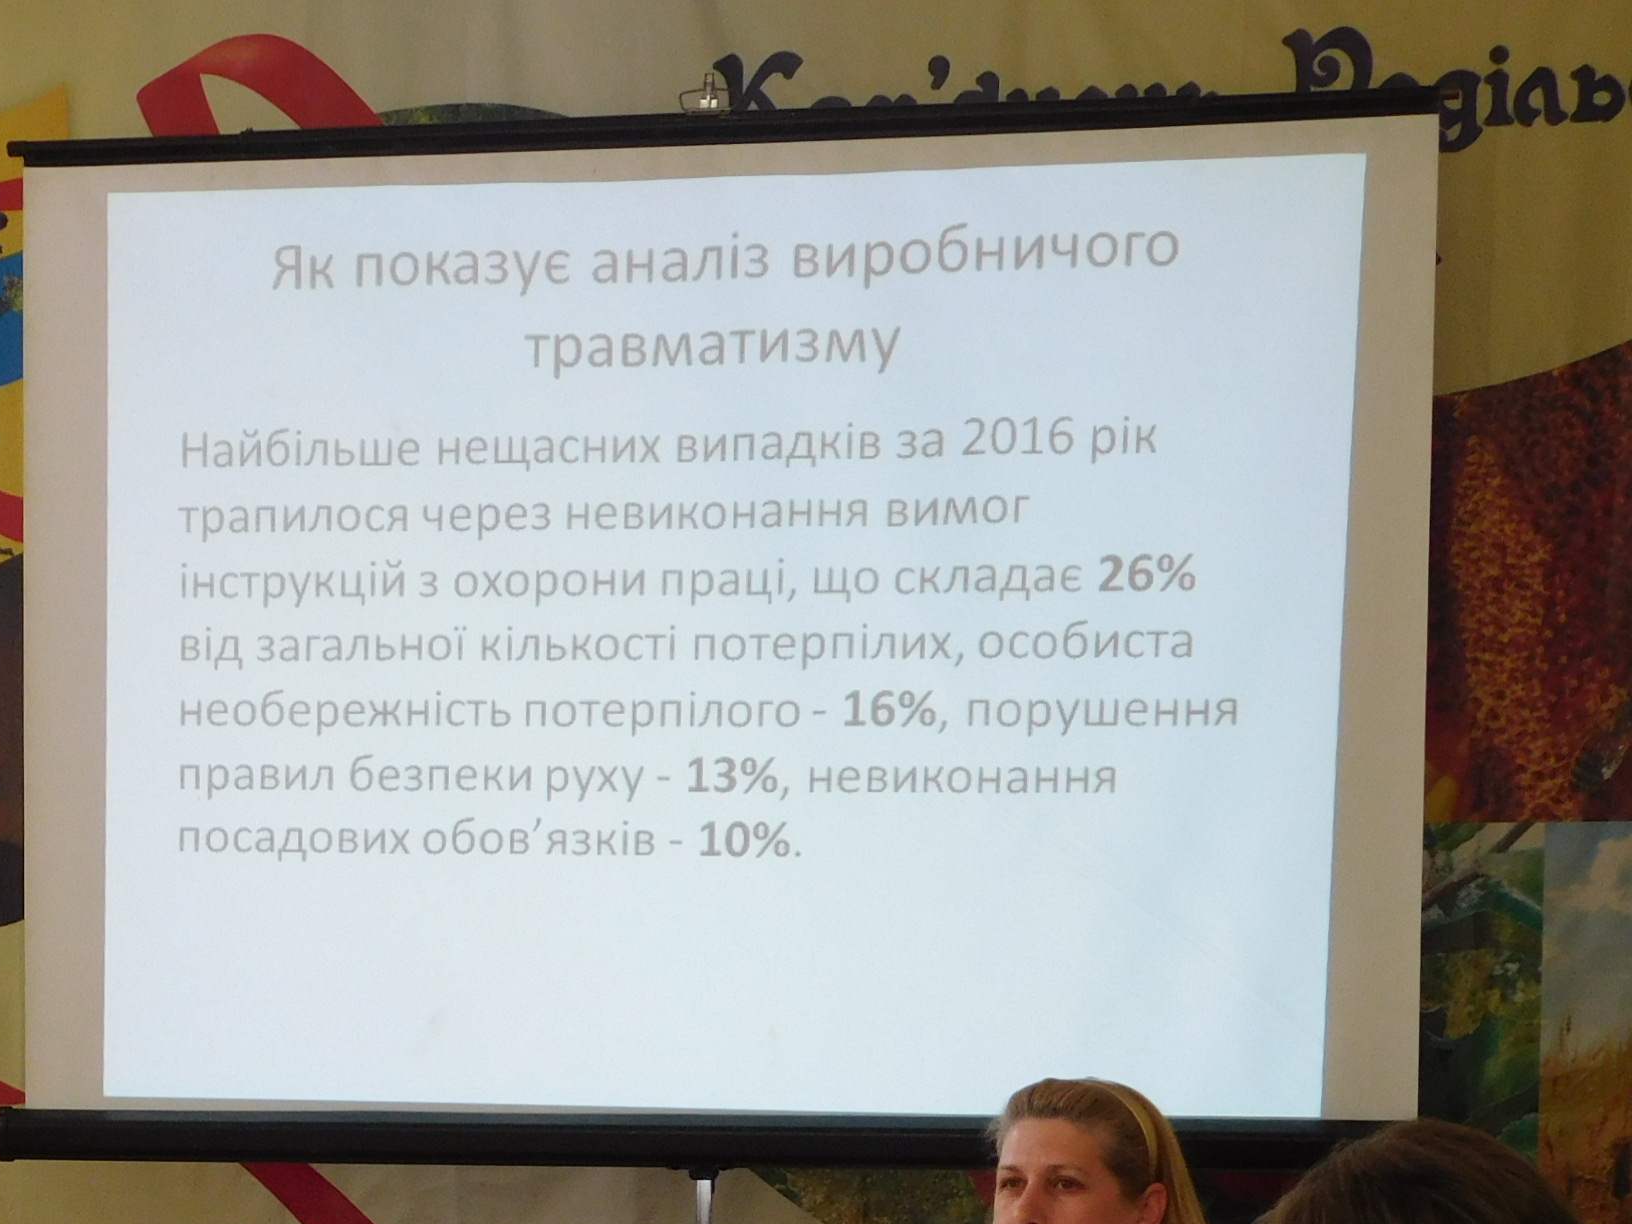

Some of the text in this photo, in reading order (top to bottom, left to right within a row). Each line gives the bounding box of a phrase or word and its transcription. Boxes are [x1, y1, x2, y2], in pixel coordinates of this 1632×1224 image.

[272, 222, 1179, 298] Як показує аналіз виробничого
[524, 325, 901, 380] травматизму
[182, 415, 1158, 472] Найбільше нещасних випадків за 2016 рік
[178, 494, 1030, 543] трапилося через невиконання вимог
[181, 553, 1196, 608] інструкцій з охорони праці, що складає 26%
[180, 620, 1194, 671] від загальної кількості потерпілих, особиста
[179, 689, 512, 737] необережність
[524, 691, 801, 737] потерпілого
[843, 689, 949, 734] 16%,
[966, 696, 1239, 737] порушення
[179, 763, 335, 800] правил
[349, 753, 533, 793] безпеки
[546, 764, 646, 803] руху
[687, 756, 791, 801] 13%,
[808, 764, 1117, 796] невиконання
[178, 825, 411, 862] посадових
[699, 820, 802, 859] 10%.
